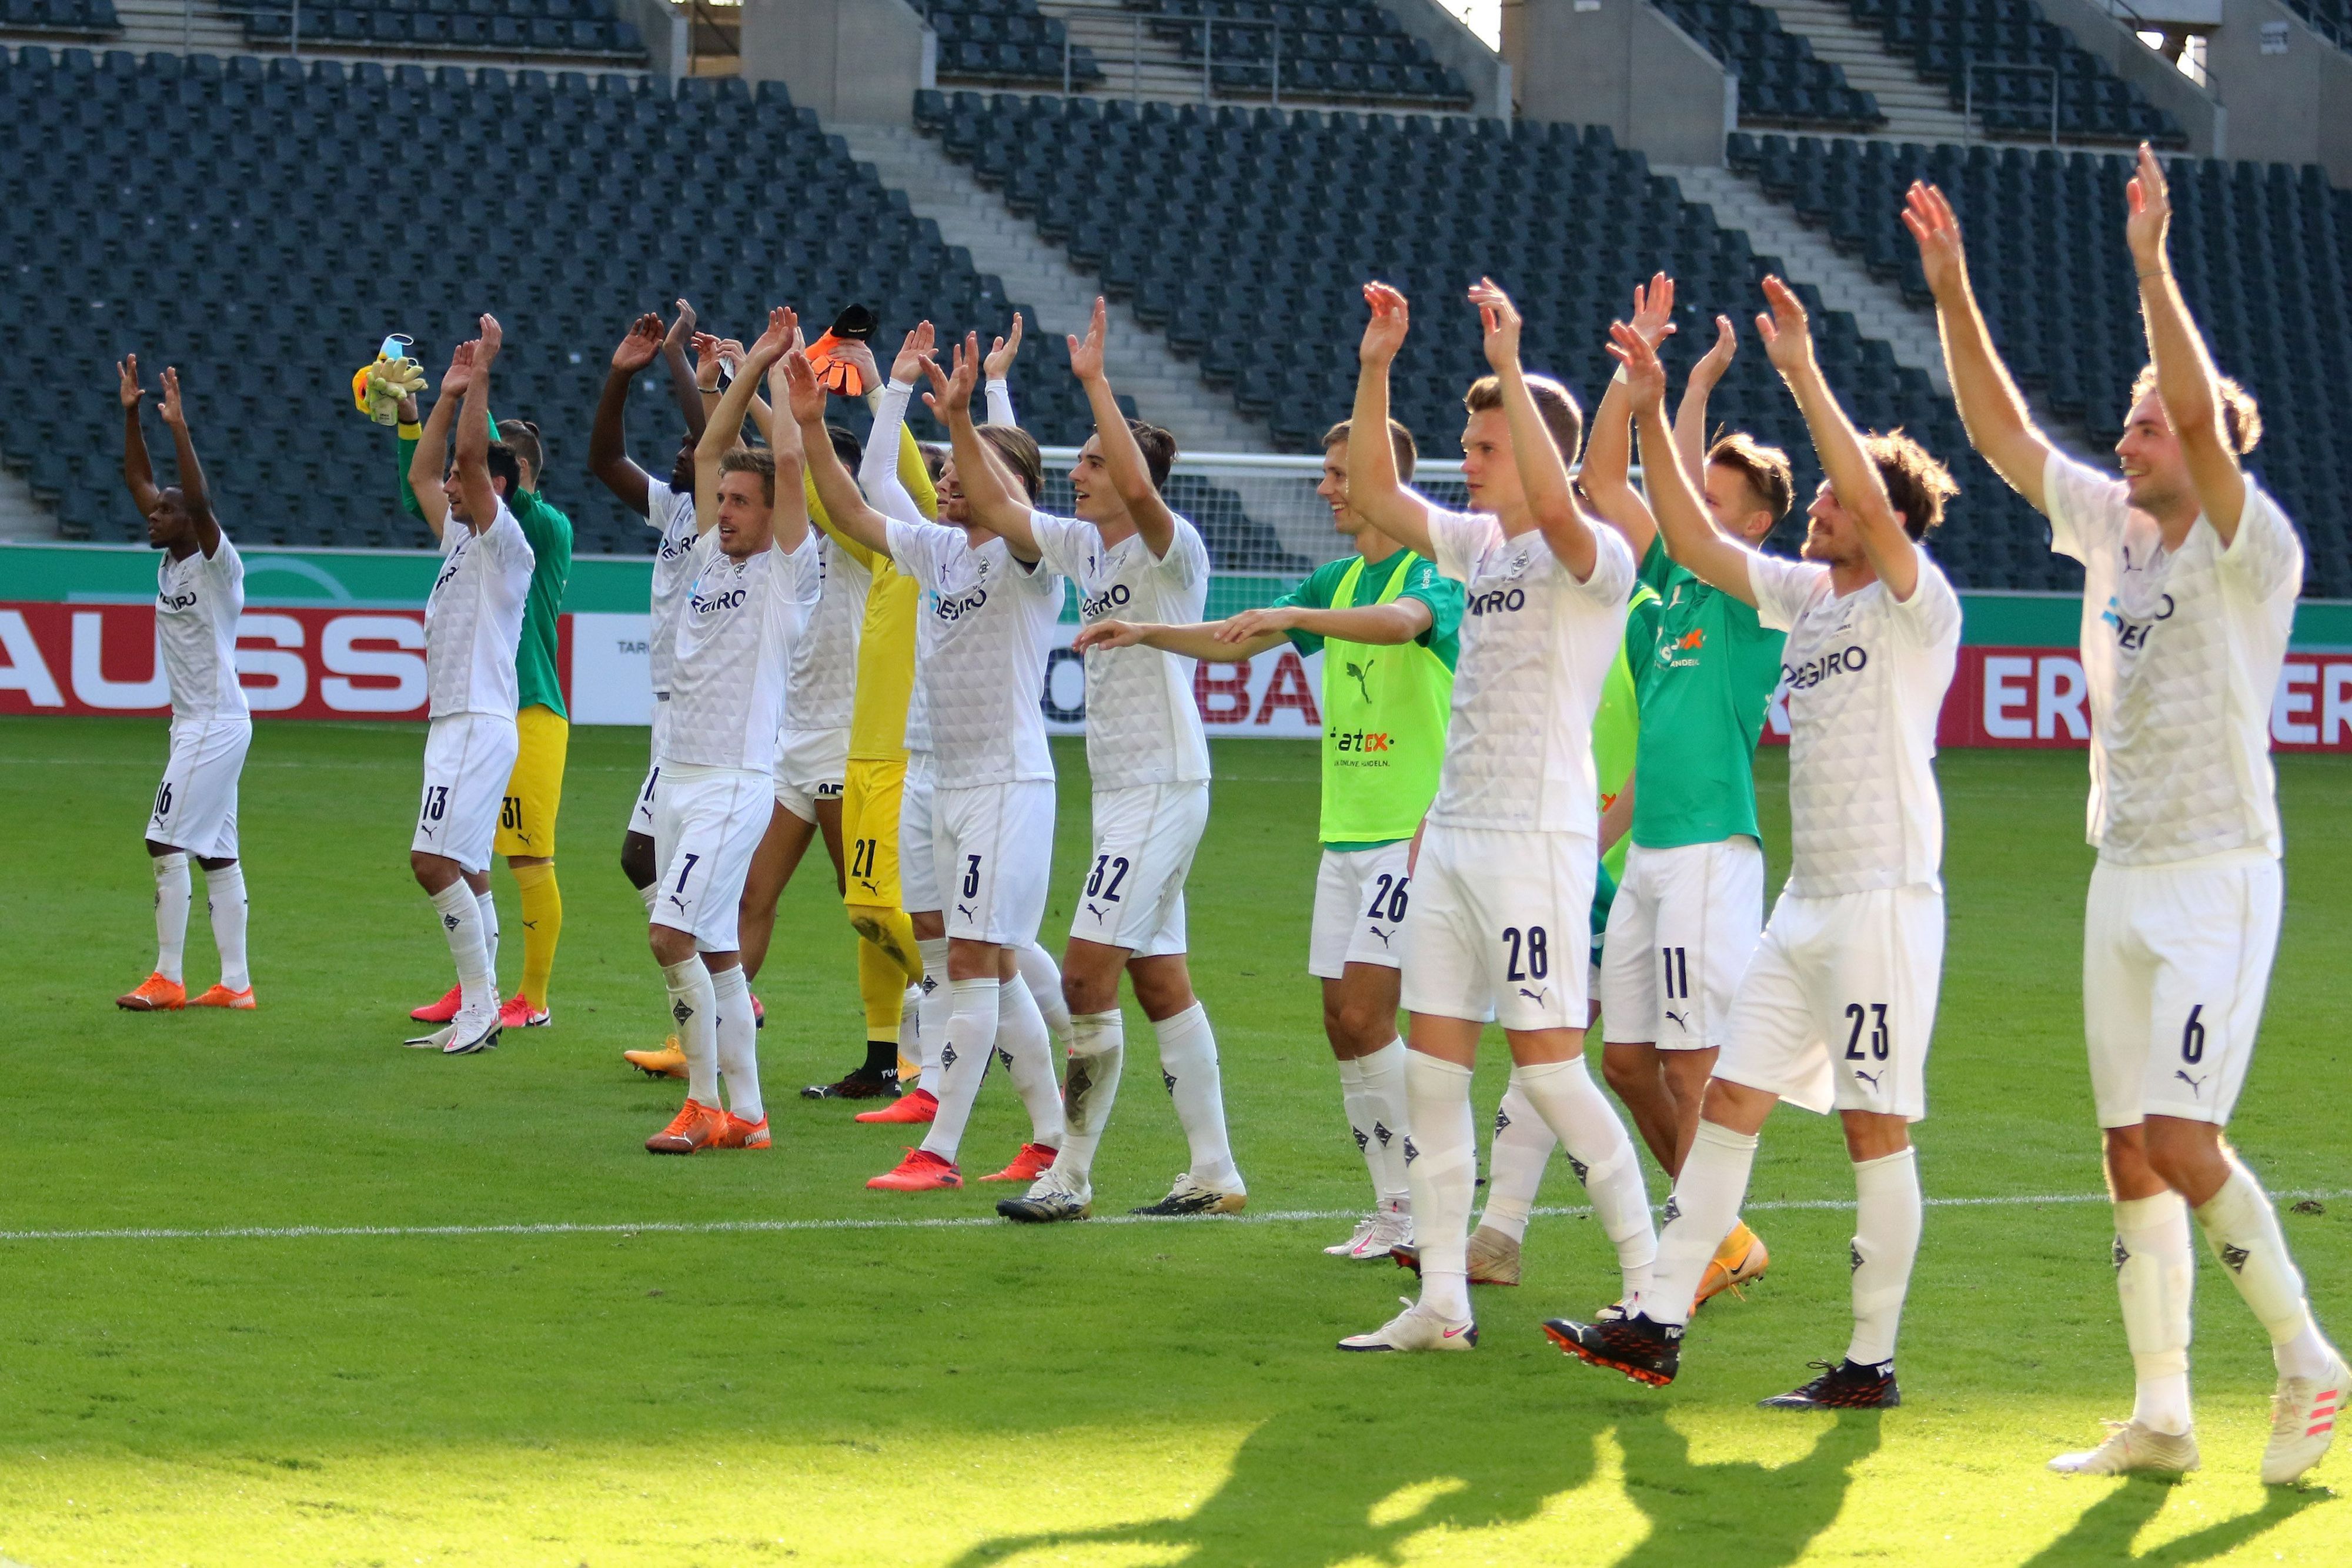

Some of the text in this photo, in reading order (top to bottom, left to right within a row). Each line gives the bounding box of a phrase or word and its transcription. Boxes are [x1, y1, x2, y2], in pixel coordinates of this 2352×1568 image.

[617, 641, 650, 654] TAR
[155, 782, 172, 815] 16
[423, 786, 449, 821] 13
[502, 797, 523, 830] 31
[675, 853, 700, 894] 7
[851, 839, 876, 877] 21
[963, 854, 982, 899] 3
[1086, 854, 1130, 902] 32
[1367, 873, 1408, 924] 26
[1502, 926, 1548, 982] 28
[1663, 947, 1688, 999] 11
[1845, 1003, 1889, 1062] 23
[2181, 1004, 2206, 1065] 6
